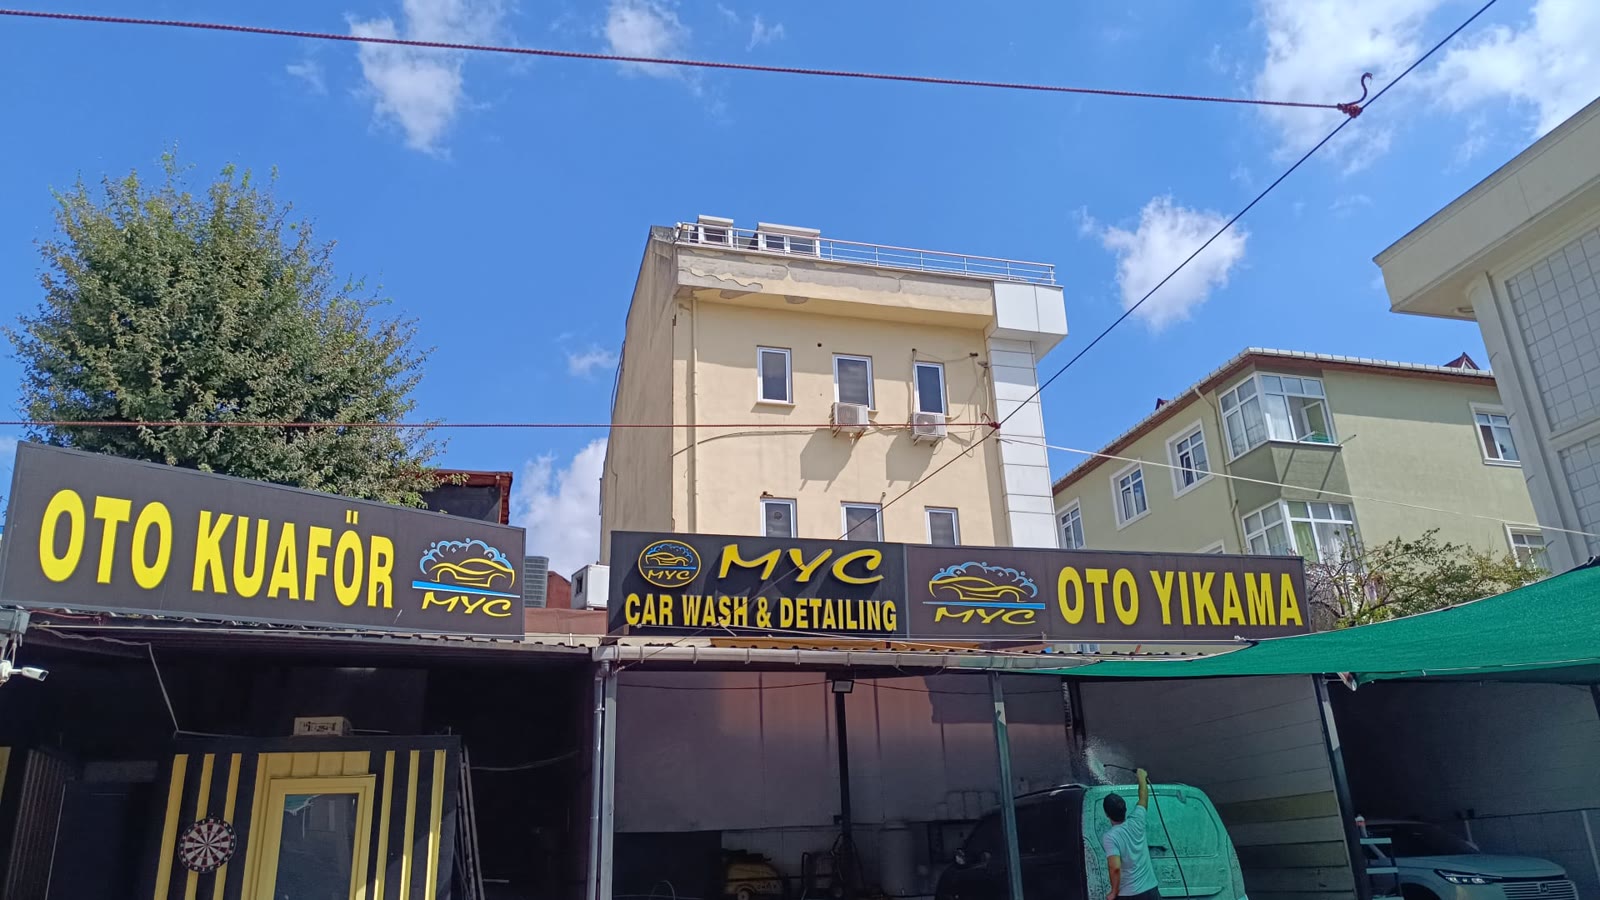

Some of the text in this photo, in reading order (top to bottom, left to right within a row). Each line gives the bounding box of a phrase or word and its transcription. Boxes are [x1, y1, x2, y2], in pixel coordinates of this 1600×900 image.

[38, 489, 394, 609] OTO KUAFÖR
[718, 544, 884, 585] MYC
[647, 570, 690, 580] MYC
[421, 590, 513, 617] MYC
[625, 593, 897, 631] CAR WASH & DETAILING
[1057, 566, 1304, 627] OTO YIKAMA
[934, 607, 1036, 625] MYC
